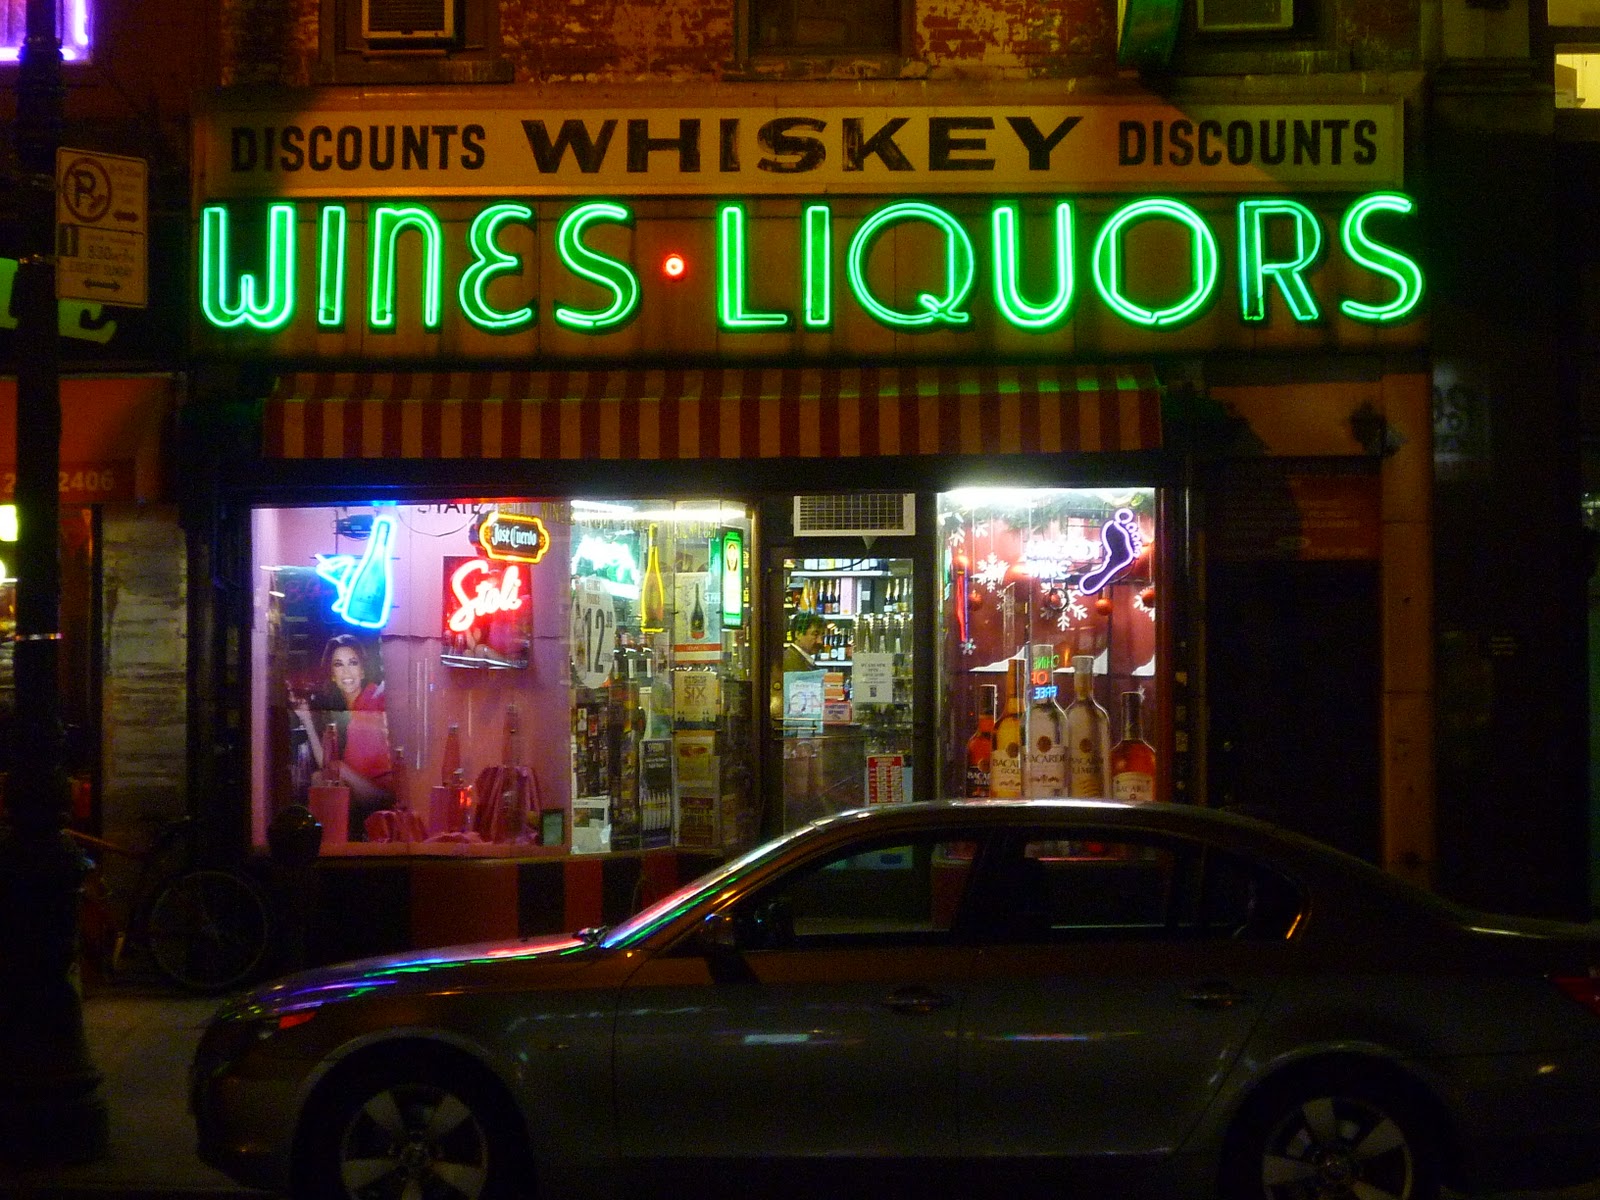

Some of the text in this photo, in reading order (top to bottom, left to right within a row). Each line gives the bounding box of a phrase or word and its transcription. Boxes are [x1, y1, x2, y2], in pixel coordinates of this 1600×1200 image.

[231, 116, 1377, 174] DISCOUNTS WHISKEY DISCOUNTS
[200, 193, 1426, 331] WINES LIQUORS
[59, 470, 114, 492] 2406
[448, 559, 523, 632] Stoli
[992, 758, 1019, 768] BACA
